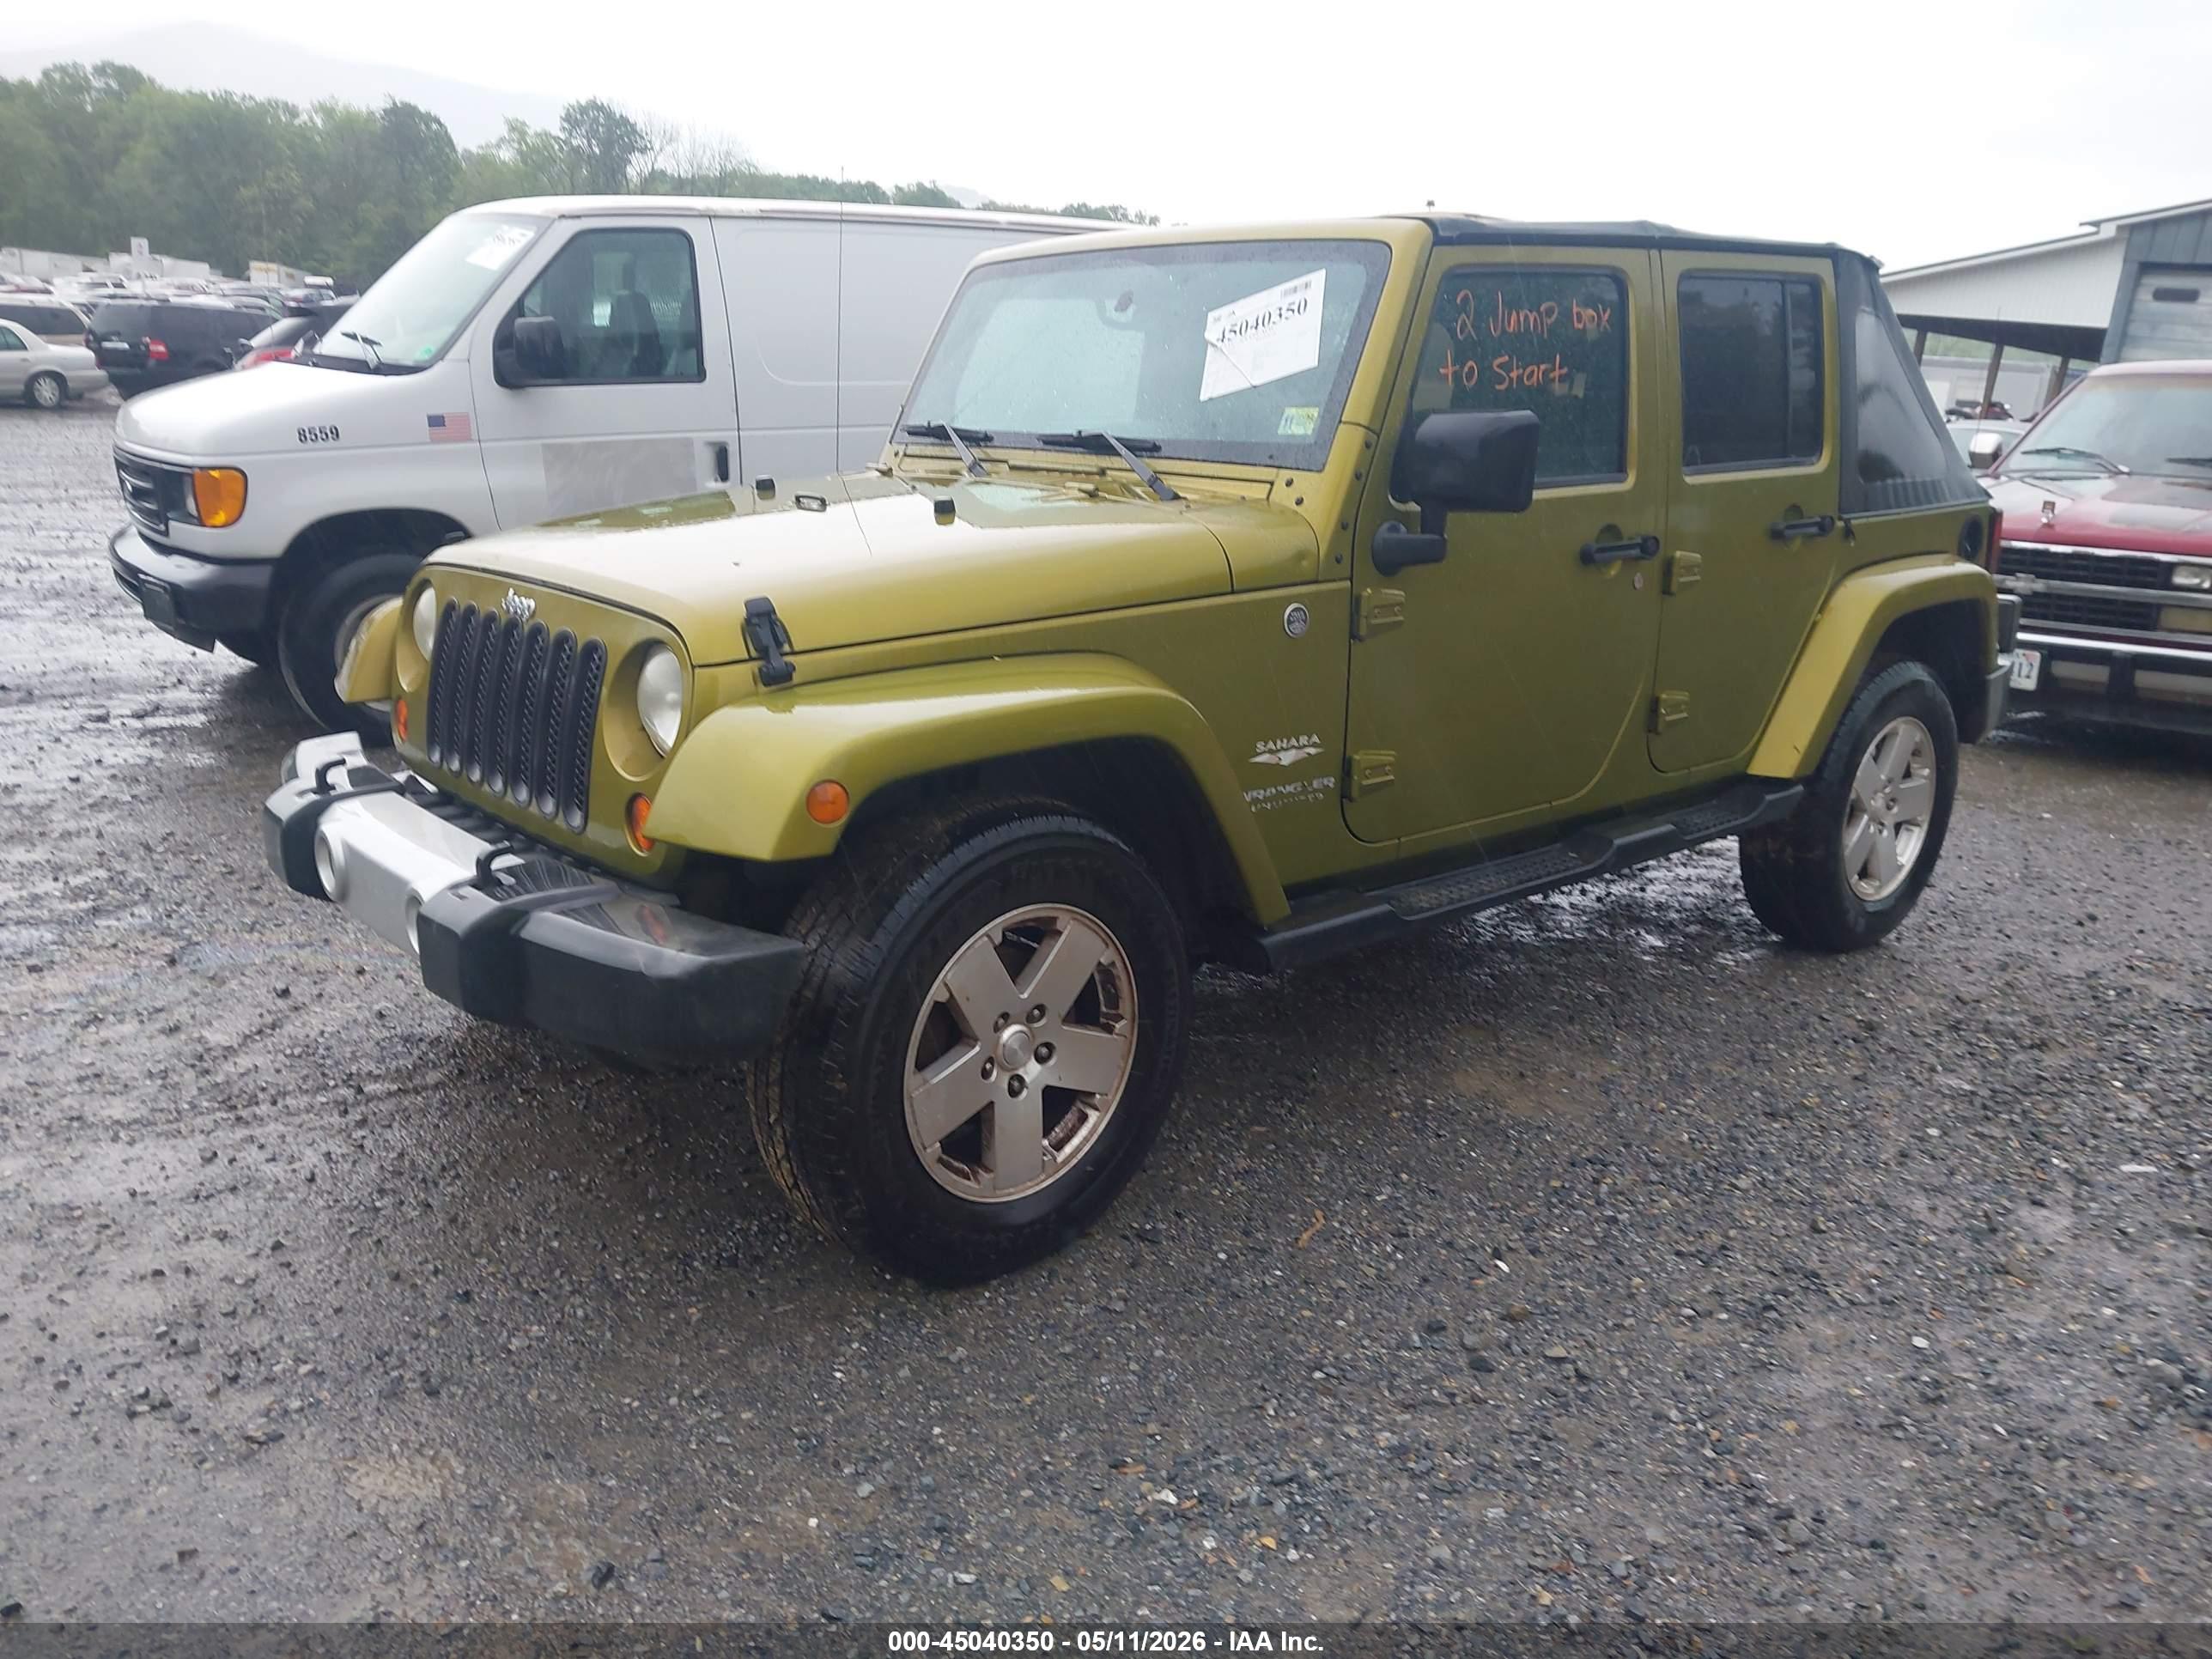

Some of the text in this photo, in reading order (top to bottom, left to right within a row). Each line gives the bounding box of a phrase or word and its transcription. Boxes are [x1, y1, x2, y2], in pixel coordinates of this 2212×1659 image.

[1216, 297, 1309, 343] 45040350
[1455, 289, 1612, 341] 2 Jump box
[1439, 349, 1568, 392] to Start
[296, 425, 341, 445] 8559
[1255, 733, 1322, 754] SAHARA
